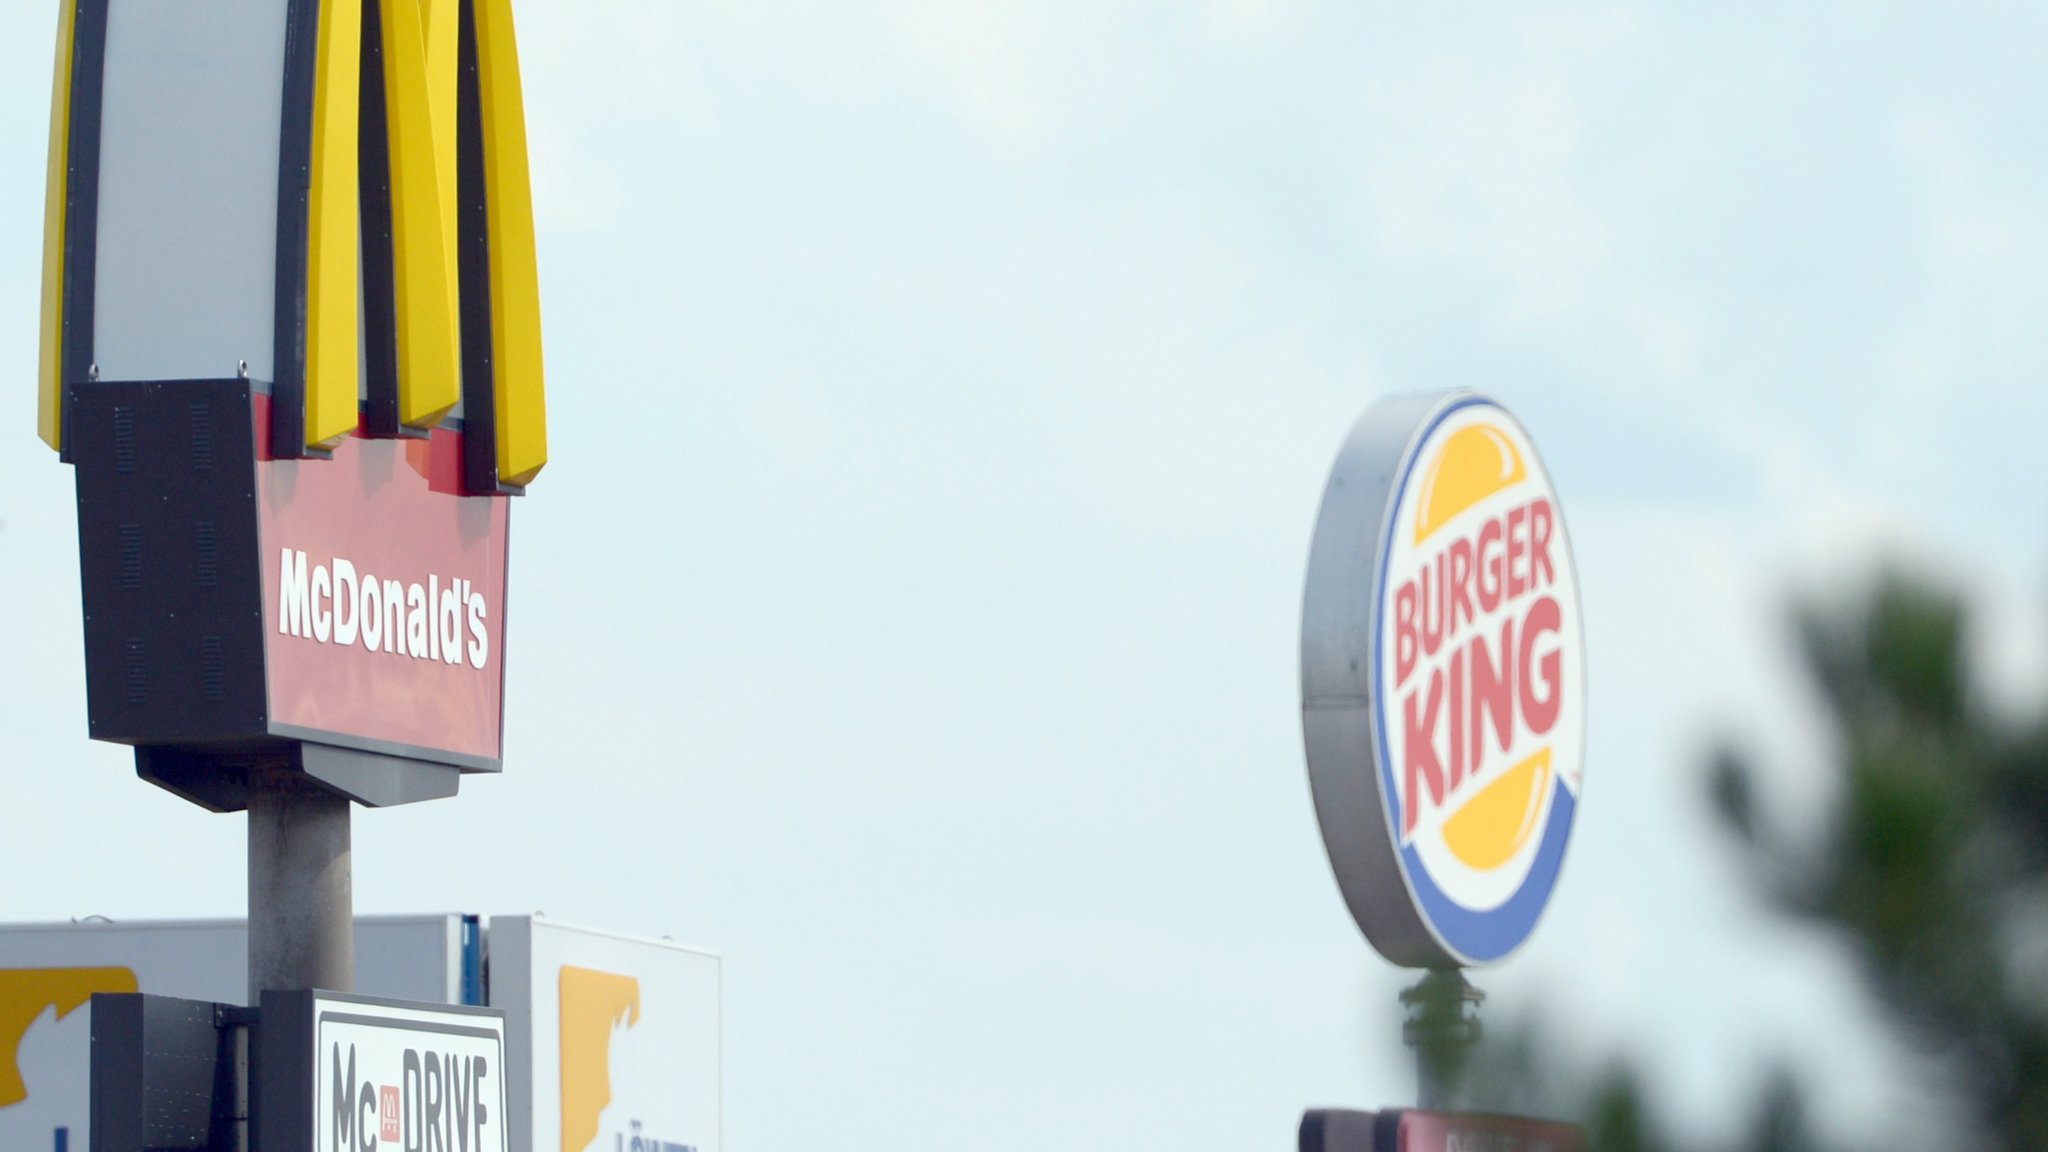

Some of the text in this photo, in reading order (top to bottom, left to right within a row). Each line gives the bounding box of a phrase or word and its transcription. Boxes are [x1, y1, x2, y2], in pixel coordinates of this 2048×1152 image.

[279, 547, 488, 669] McDonald's
[1395, 497, 1556, 689] BURGER
[1402, 596, 1562, 835] KING
[333, 1041, 377, 1152] Mc
